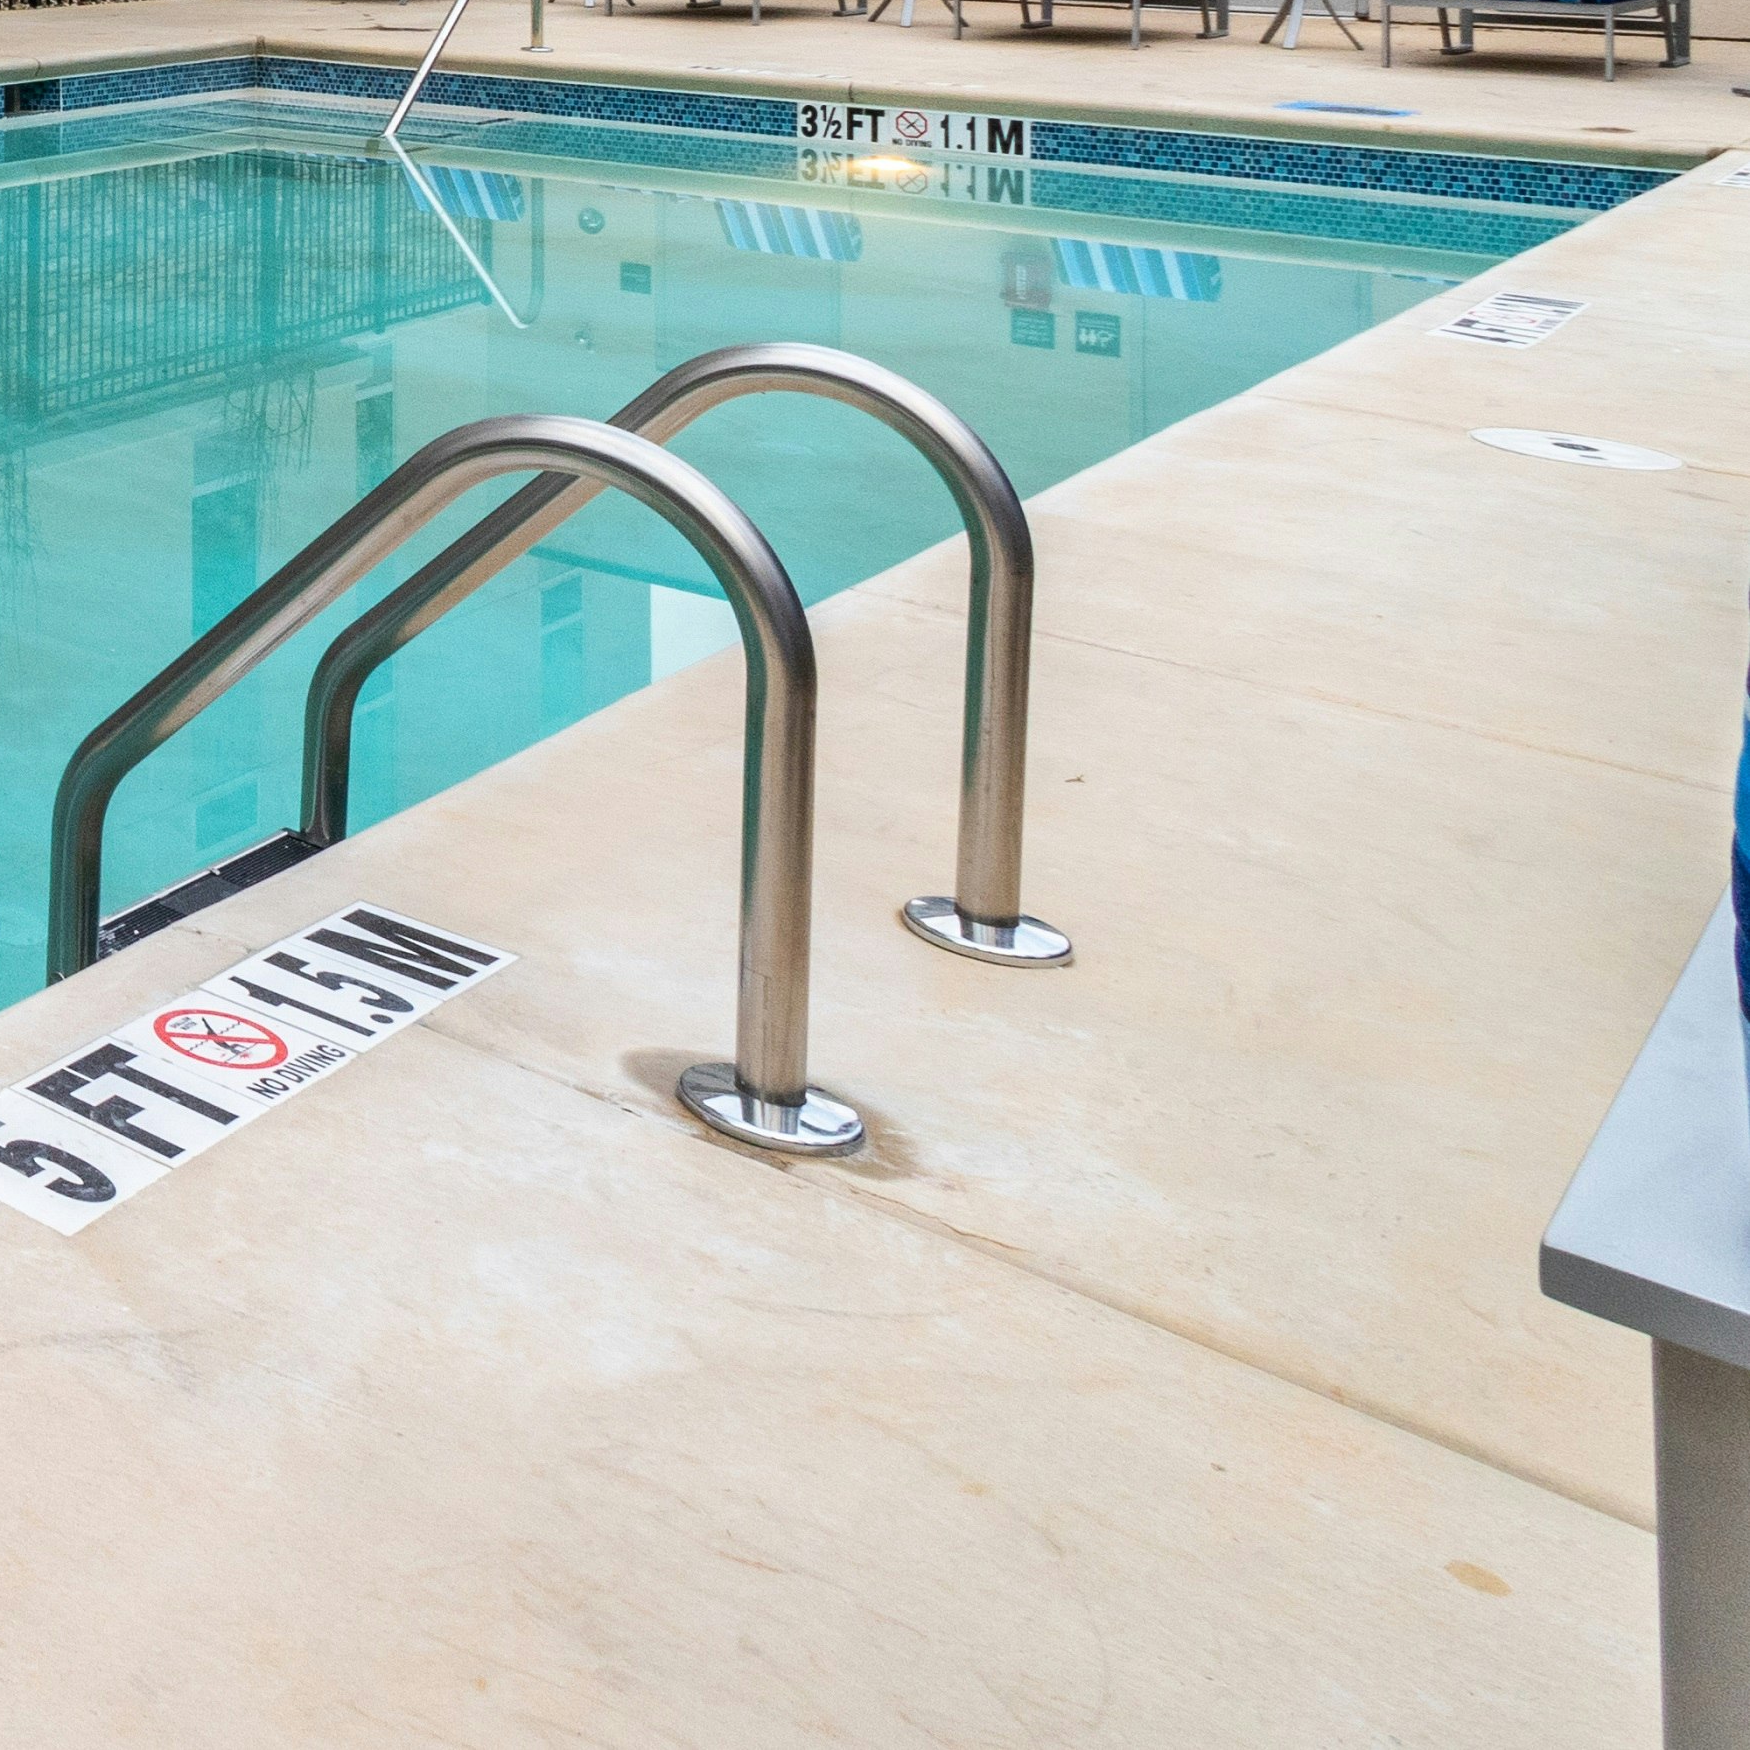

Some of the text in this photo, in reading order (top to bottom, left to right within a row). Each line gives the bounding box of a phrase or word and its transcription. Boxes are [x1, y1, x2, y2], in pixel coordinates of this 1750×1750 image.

[846, 106, 885, 143] FT
[940, 114, 1024, 155] 1.1 M
[229, 908, 500, 1037] 1.5 M
[246, 1044, 346, 1099] NO DIVING
[26, 1043, 239, 1159] FT
